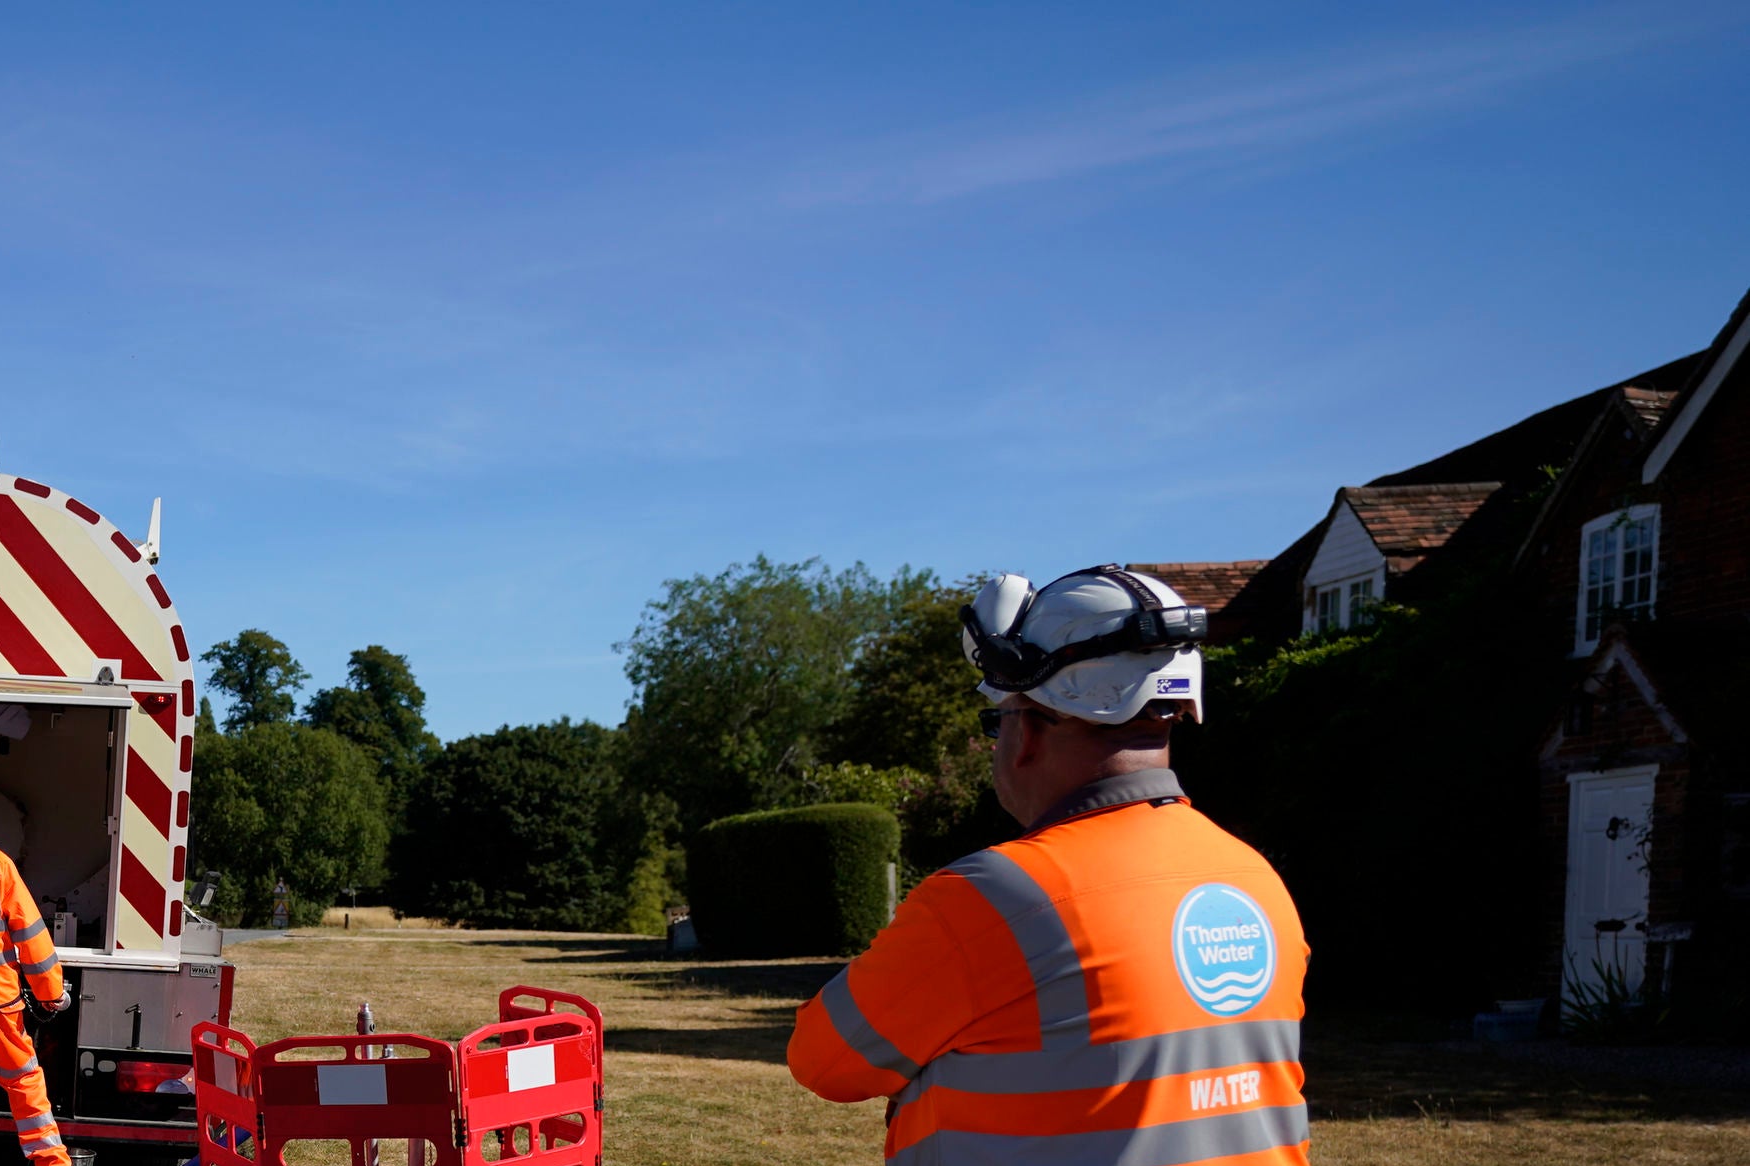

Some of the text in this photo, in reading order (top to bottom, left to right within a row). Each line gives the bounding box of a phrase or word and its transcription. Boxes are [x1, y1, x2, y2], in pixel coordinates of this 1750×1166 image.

[1184, 923, 1261, 945] Thames
[1198, 944, 1255, 966] Water
[1190, 1070, 1261, 1111] WATER
